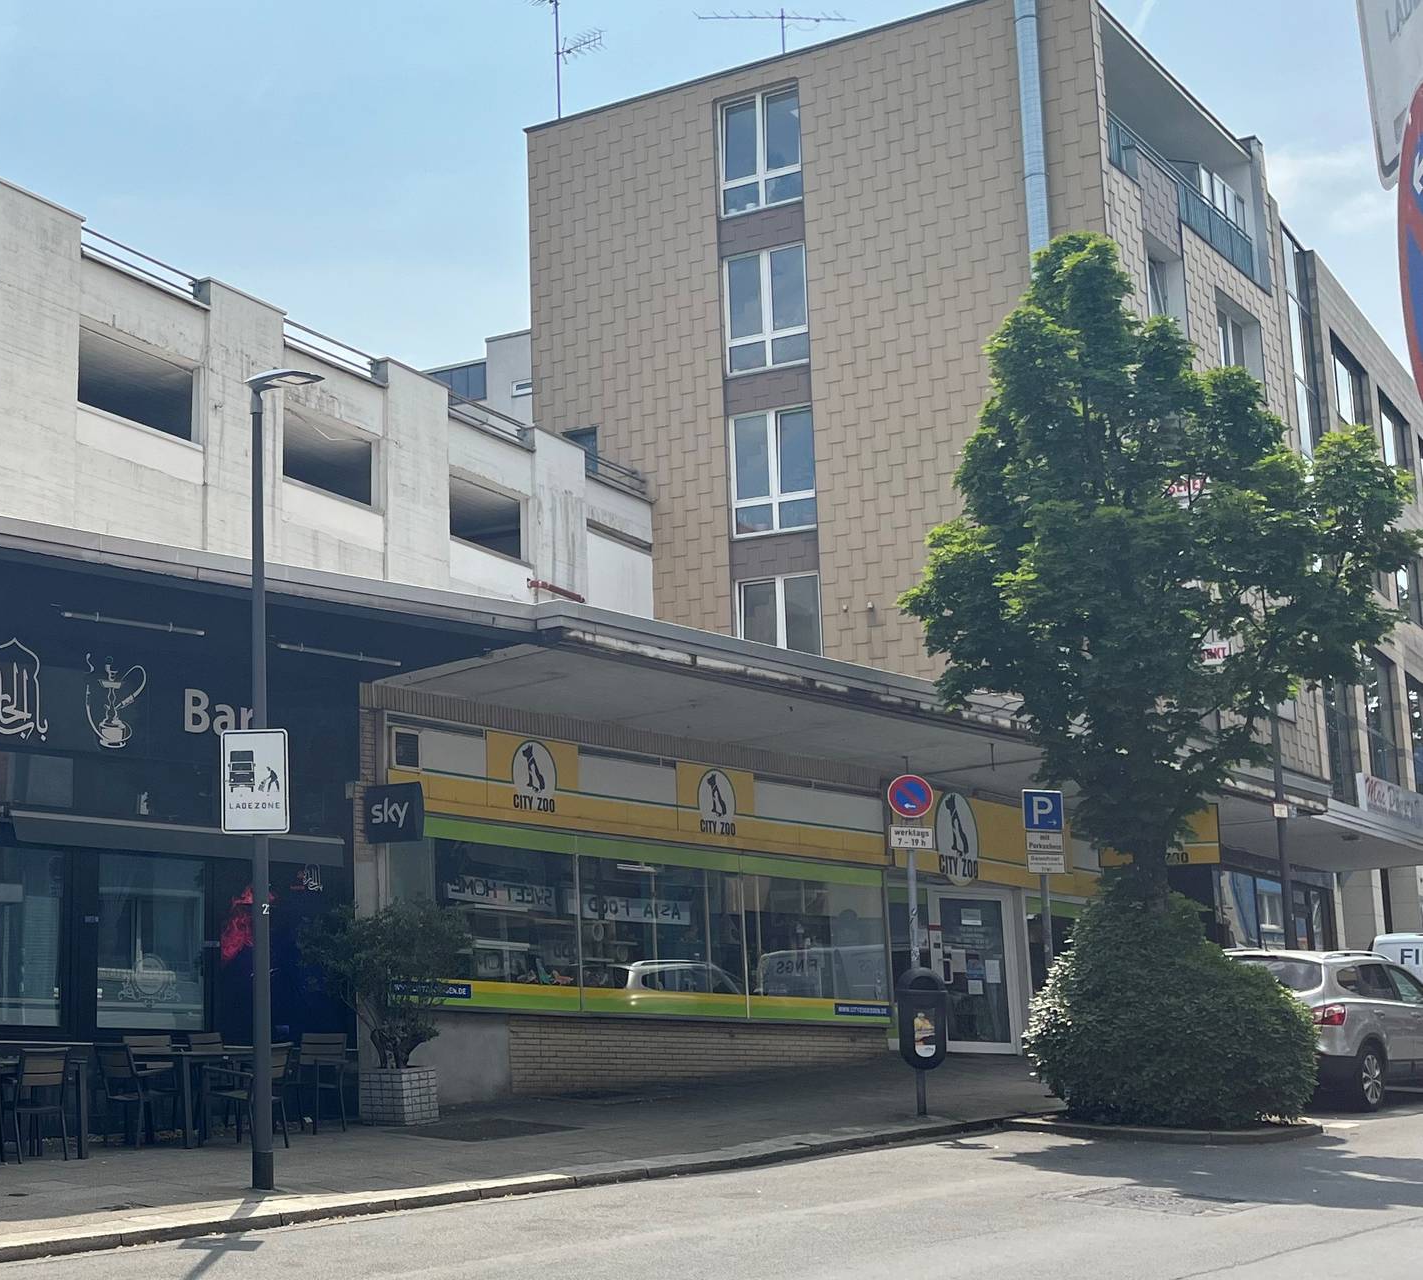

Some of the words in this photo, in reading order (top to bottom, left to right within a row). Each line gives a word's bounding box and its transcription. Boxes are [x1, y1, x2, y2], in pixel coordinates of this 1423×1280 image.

[184, 688, 254, 737] Bar
[229, 802, 281, 810] LADEZONE
[371, 797, 409, 828] sky
[513, 794, 533, 811] CITY
[537, 797, 555, 813] ZOO
[1032, 796, 1053, 825] P
[700, 819, 717, 835] CITY
[720, 821, 736, 836] ZOO
[894, 829, 930, 839] werktags
[897, 838, 902, 846] 7
[911, 838, 920, 847] 19
[938, 854, 958, 876] CITY
[961, 858, 979, 879] ZOO
